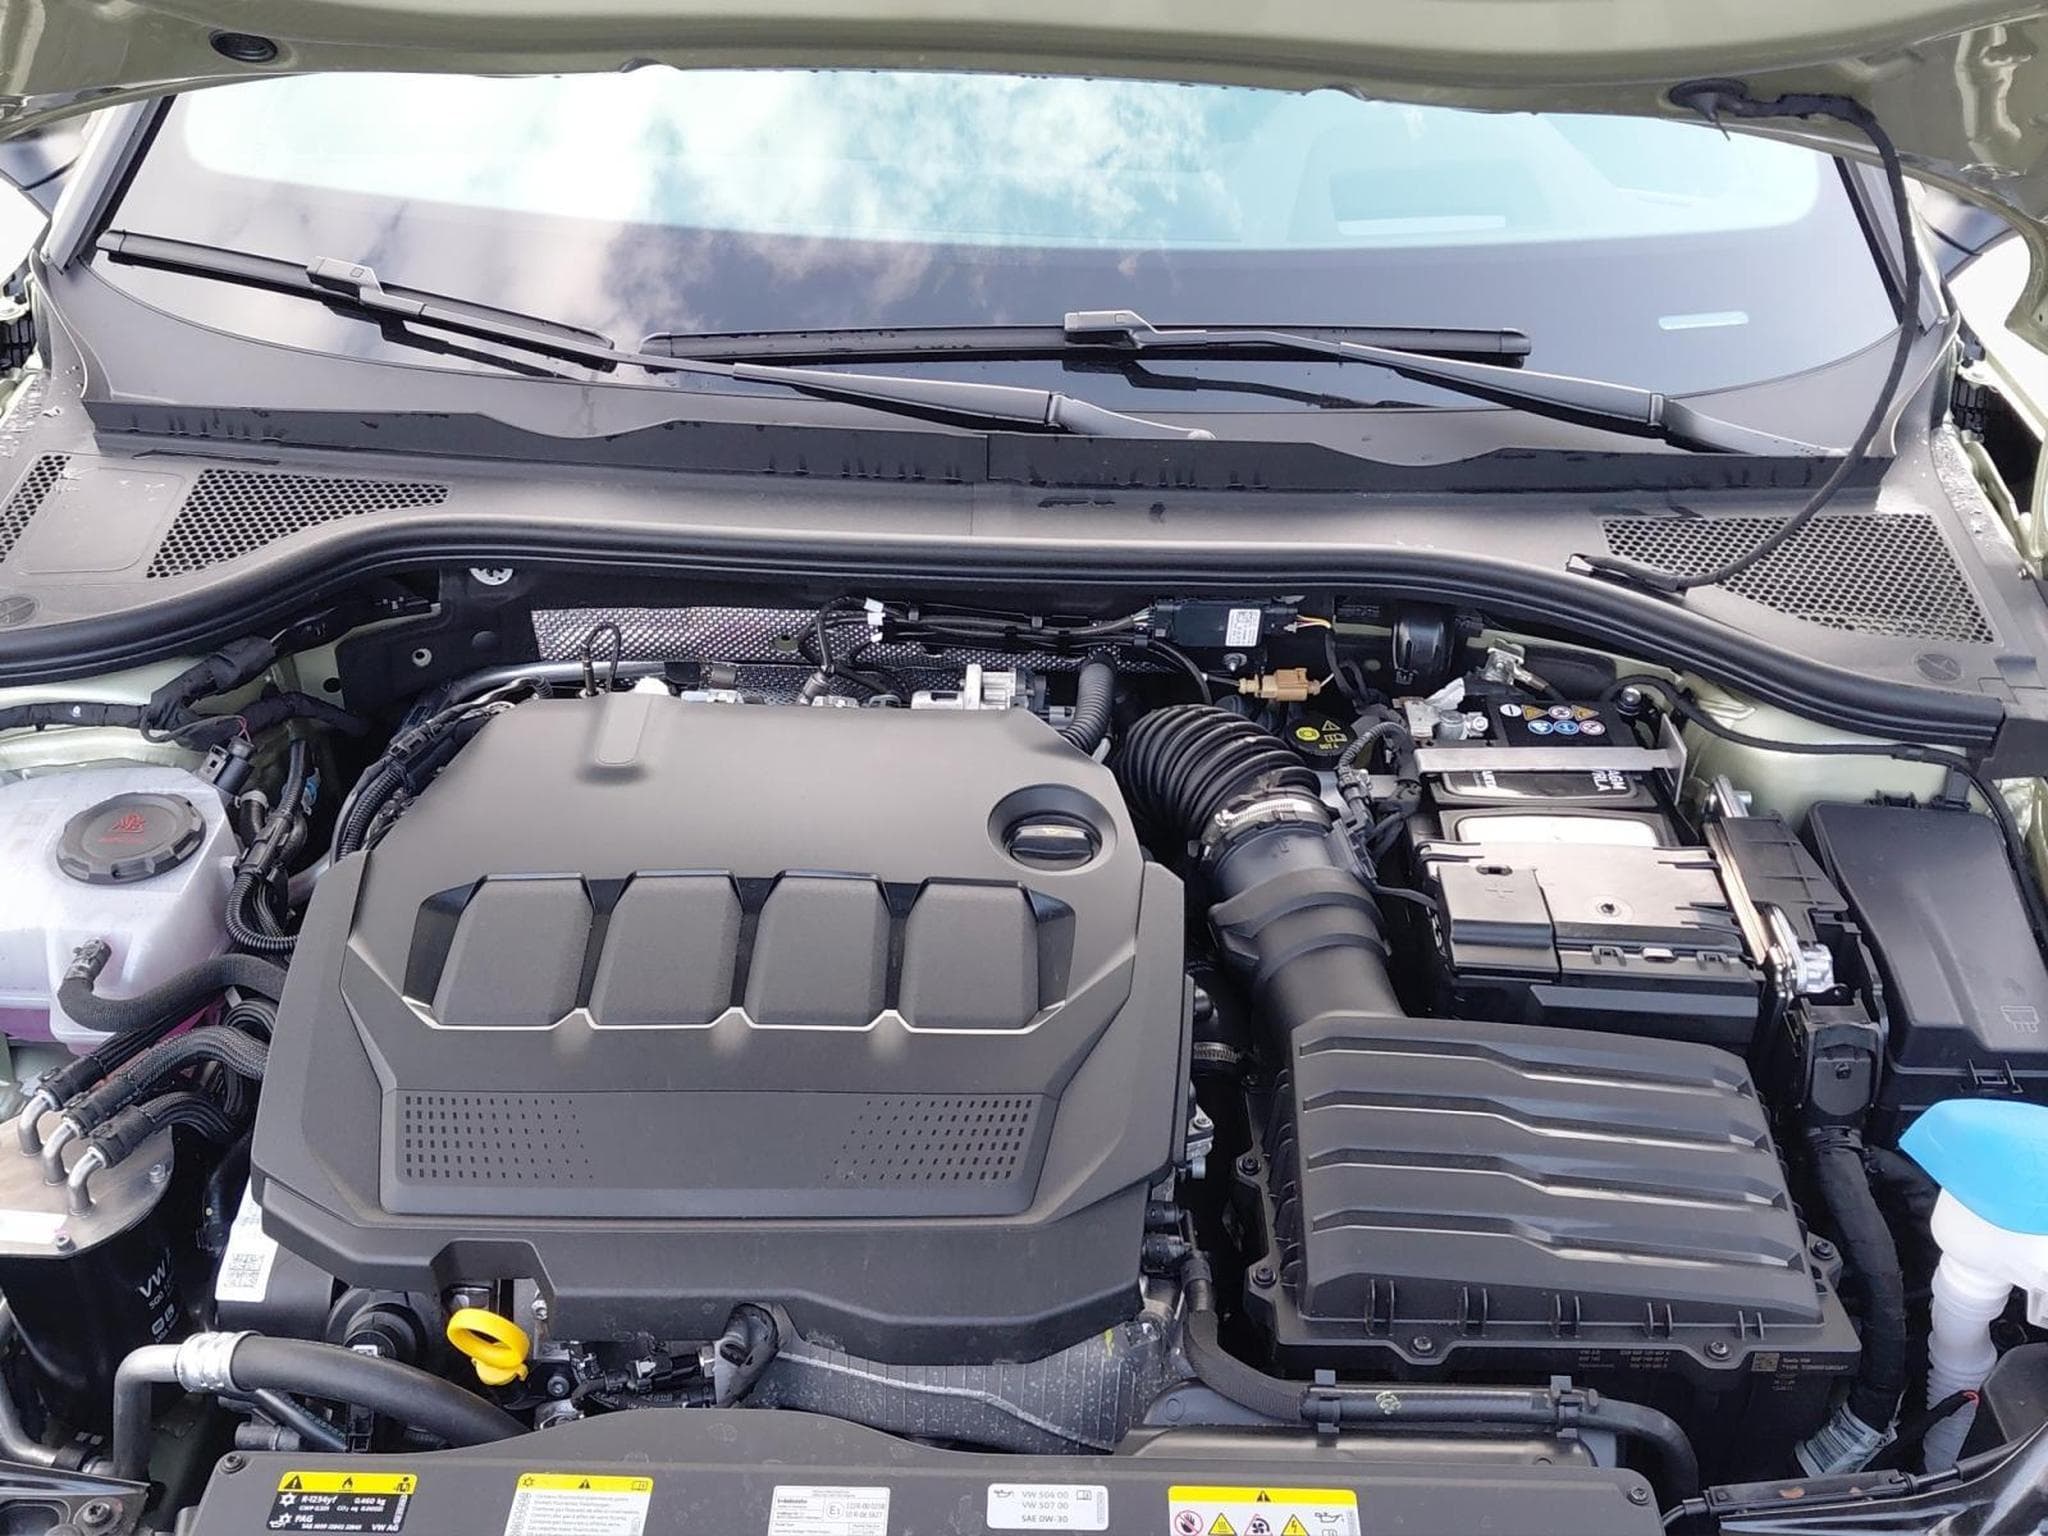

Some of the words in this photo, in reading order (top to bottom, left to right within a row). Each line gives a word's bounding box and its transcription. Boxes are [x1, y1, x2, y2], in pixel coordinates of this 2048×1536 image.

[1592, 771, 1611, 792] RLA
[1608, 769, 1627, 790] AGM
[138, 1260, 167, 1299] VW
[1057, 1491, 1070, 1499] 00
[377, 1497, 386, 1506] kg
[1022, 1501, 1036, 1509] VW
[1039, 1501, 1055, 1509] 507
[1057, 1501, 1070, 1510] 00
[294, 1514, 314, 1523] PAG
[1021, 1514, 1037, 1523] SAE
[1038, 1515, 1069, 1523] 0W-30
[371, 1523, 386, 1531] VW
[386, 1523, 400, 1532] AG
